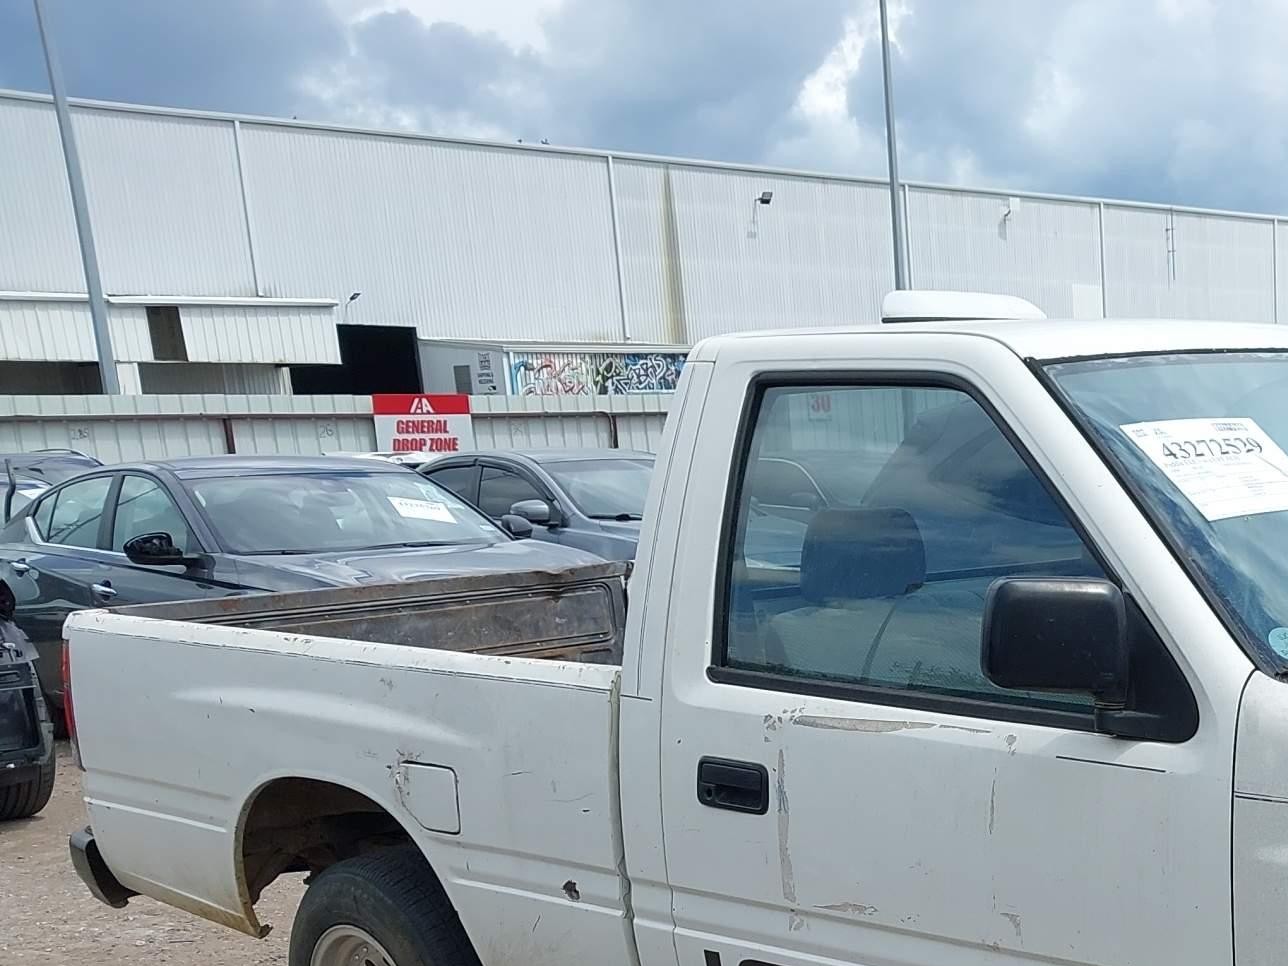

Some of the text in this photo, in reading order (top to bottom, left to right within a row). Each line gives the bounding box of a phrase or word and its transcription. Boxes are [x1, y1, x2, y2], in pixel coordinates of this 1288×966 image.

[396, 419, 449, 435] GENERAL
[392, 437, 459, 453] DROP ZONE
[1162, 437, 1263, 460] 43272529
